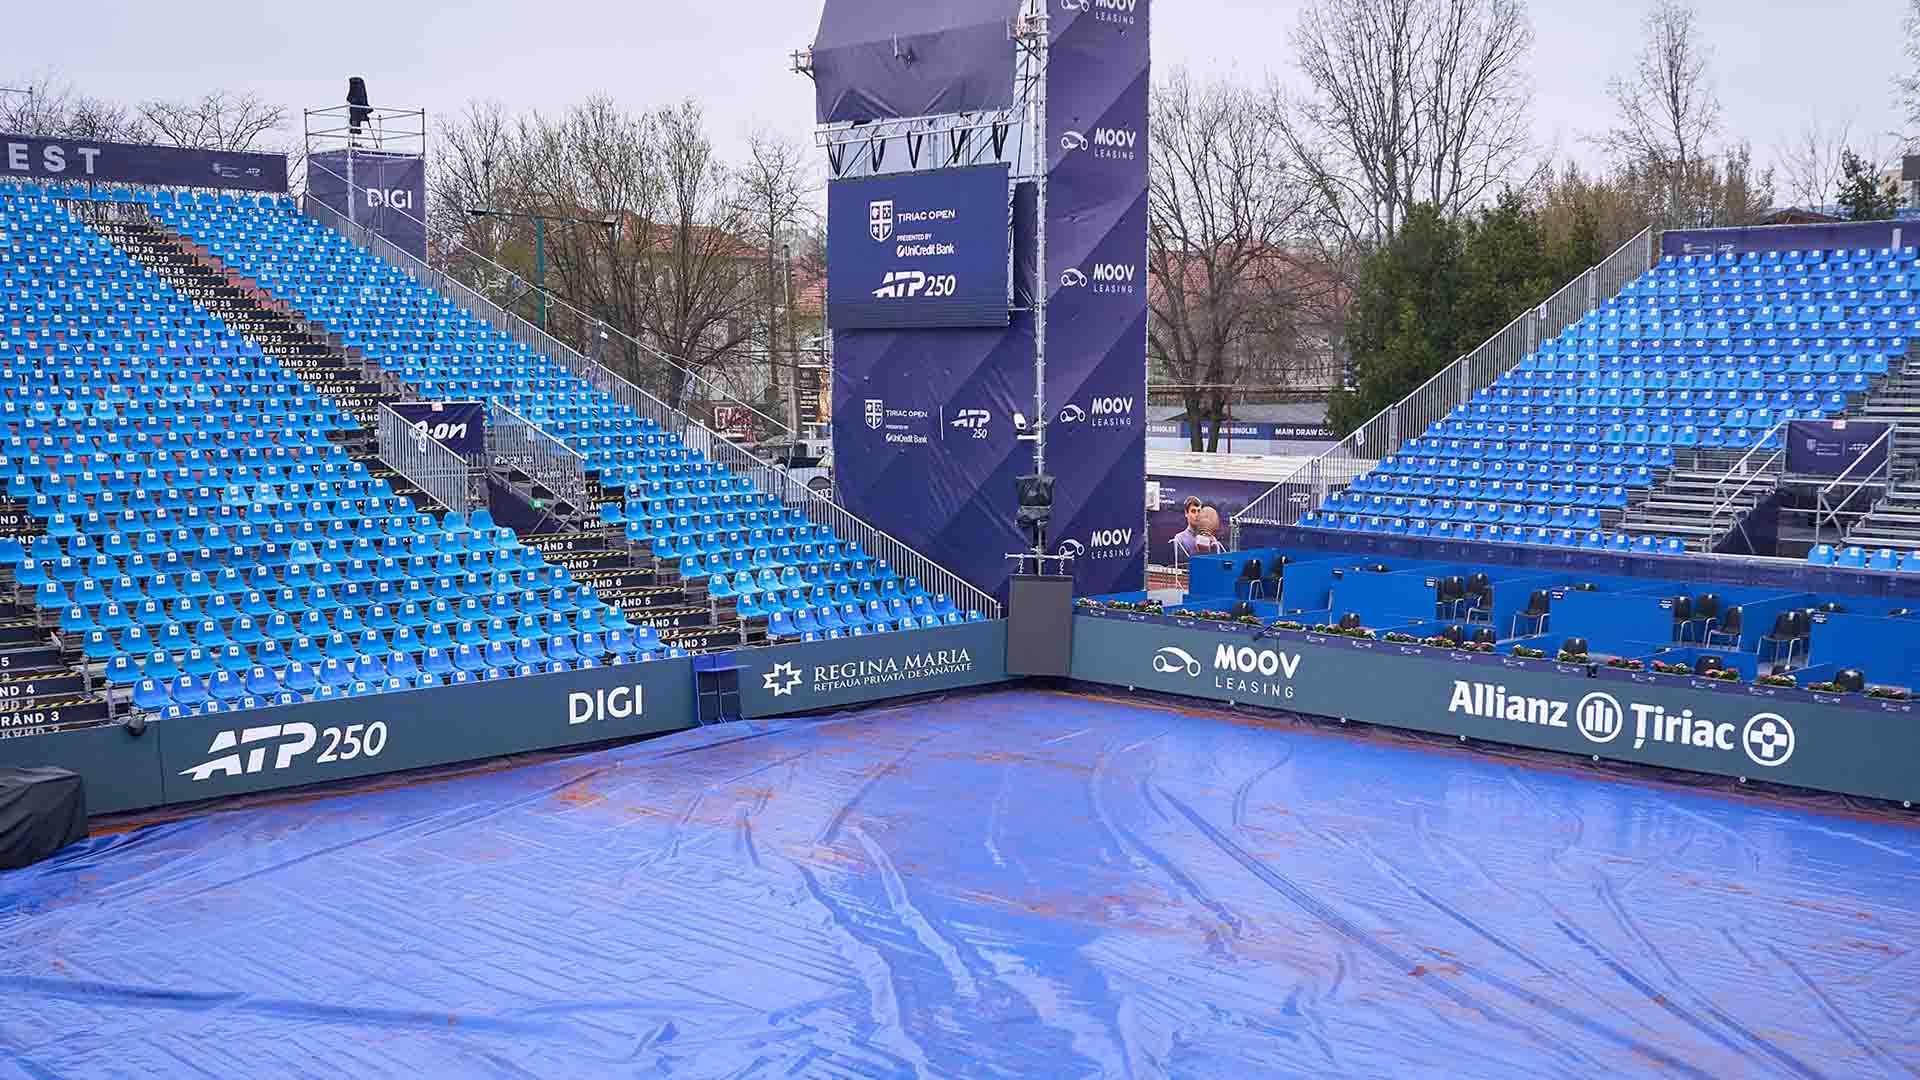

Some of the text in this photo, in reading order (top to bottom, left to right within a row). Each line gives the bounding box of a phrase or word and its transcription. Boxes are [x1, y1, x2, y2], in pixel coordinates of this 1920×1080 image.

[1095, 12, 1135, 25] LEASING
[1094, 127, 1136, 149] MOOV
[1094, 149, 1135, 161] LEASING
[366, 188, 412, 209] DIGI
[896, 209, 956, 224] TIRIAC OPEN
[905, 243, 955, 257] UniCredit Bank
[1093, 263, 1135, 282] MOOV
[872, 270, 957, 298] ATP 250
[1093, 283, 1133, 294] LEASING
[1091, 396, 1133, 416] MOOV
[886, 409, 928, 419] TIRIAC OPEN
[951, 409, 992, 428] ATP
[1091, 416, 1132, 427] LEASING
[972, 428, 988, 440] 250
[1090, 527, 1133, 548] MOOV
[566, 541, 574, 550] 8
[1090, 548, 1132, 560] LEASING
[592, 559, 599, 568] 7
[616, 578, 622, 587] 6
[644, 597, 652, 606] 5
[672, 618, 680, 627] 4
[701, 638, 708, 647] 3
[814, 648, 971, 683] REGINA MARIA
[1213, 643, 1301, 680] MOOV
[908, 669, 922, 679] DE
[1215, 676, 1294, 698] LEASING
[569, 685, 643, 725] DIGI
[1, 711, 60, 727] RÂND 3
[1448, 679, 1736, 750] Allianz Țiriac
[177, 720, 388, 782] ATP 250
